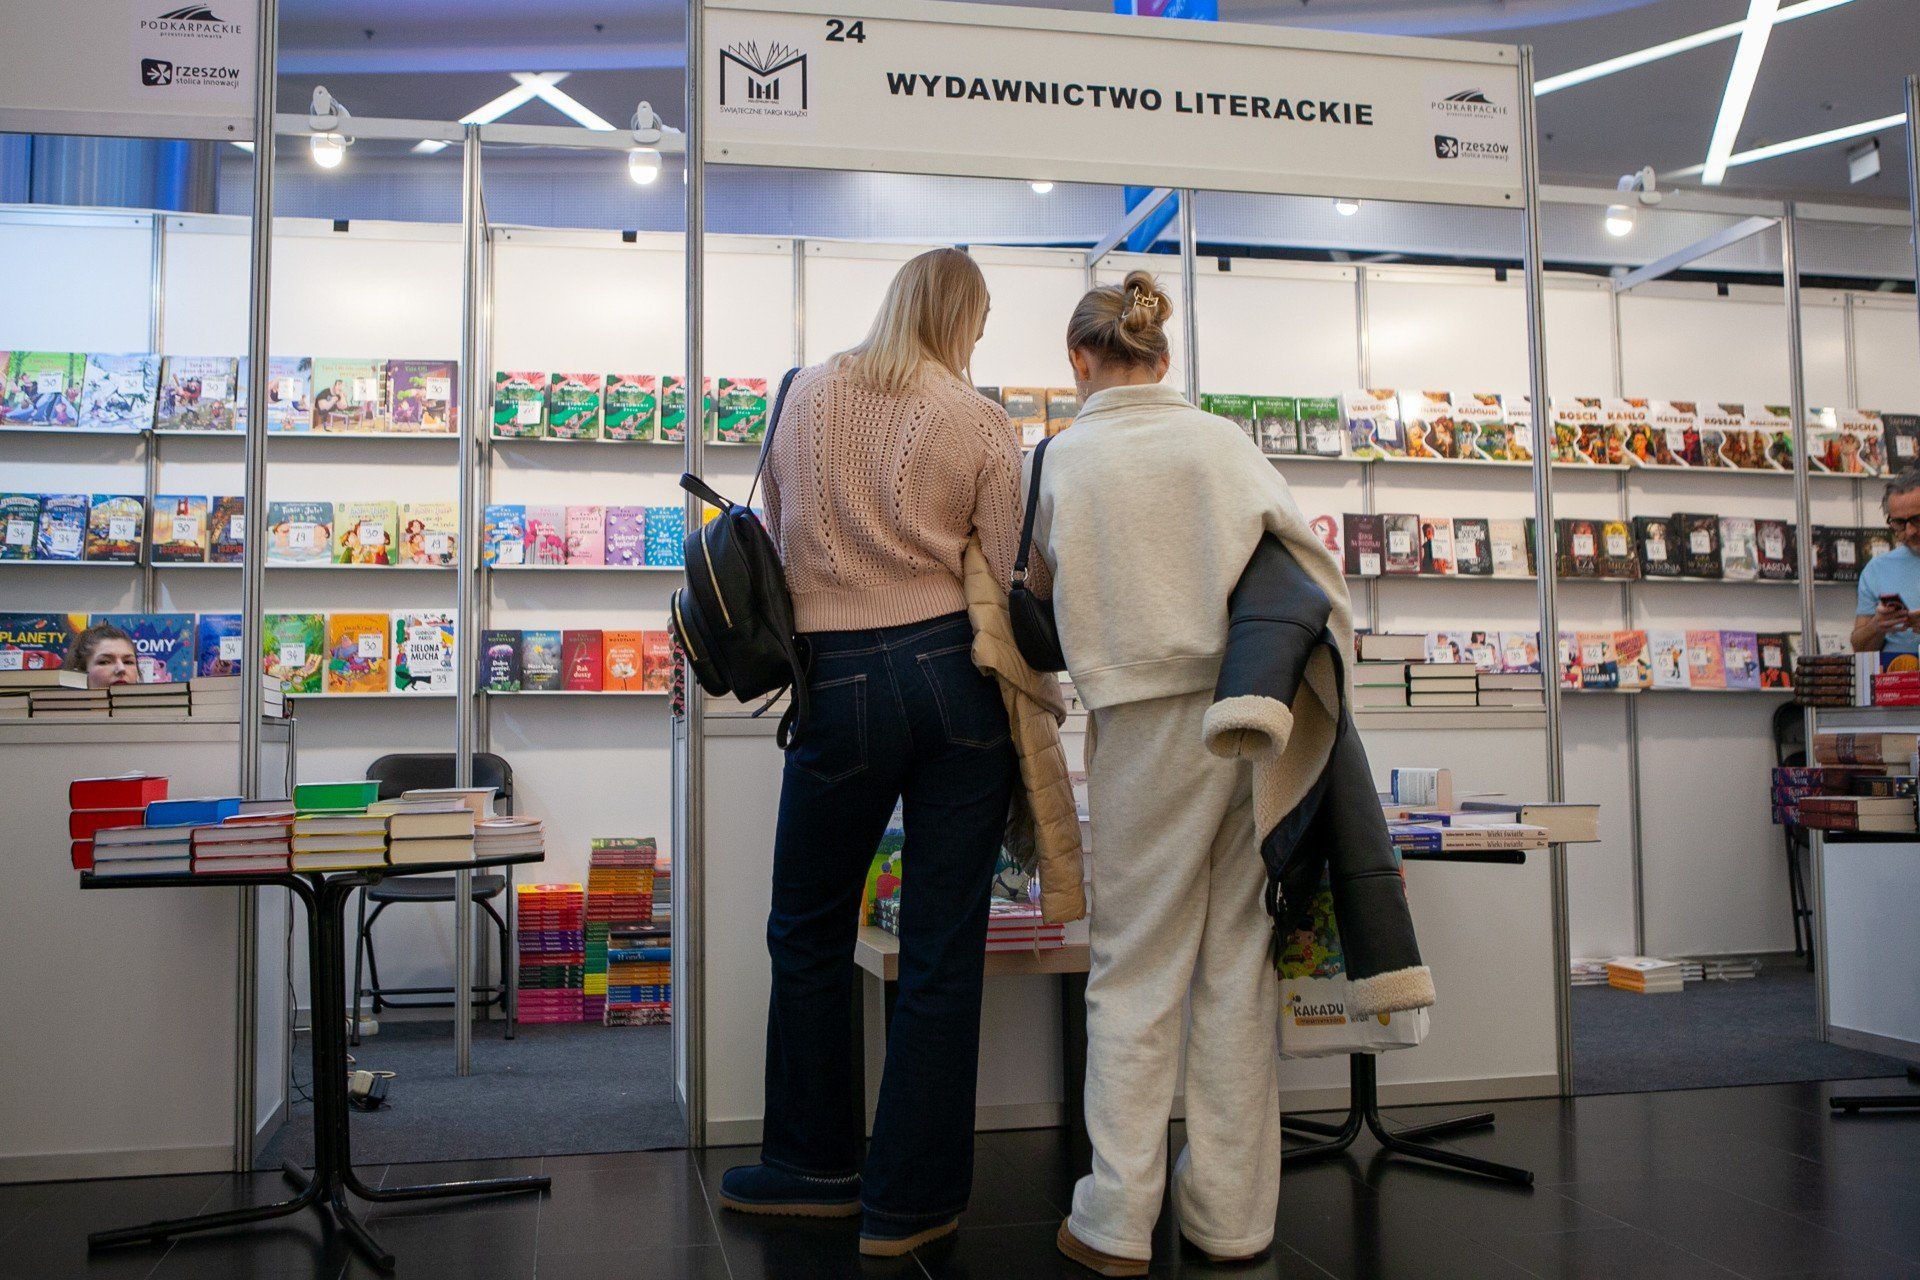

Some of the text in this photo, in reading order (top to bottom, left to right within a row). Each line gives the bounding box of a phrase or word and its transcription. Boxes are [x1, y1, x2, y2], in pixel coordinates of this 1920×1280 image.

[140, 20, 242, 34] PODKARPACKIE
[825, 19, 866, 43] 24
[175, 66, 240, 79] rzeszów
[175, 78, 240, 90] stolica innowacji
[886, 72, 1375, 126] WYDAWNICTWO LITERACKIE
[719, 105, 808, 118] ŚWIĄTECZNE TARGI KSIĄŻKI
[1431, 101, 1508, 115] PODKARPACKIE
[1460, 141, 1509, 153] rzeszów
[1352, 404, 1367, 413] VAN
[1559, 412, 1598, 420] BOSCH
[1607, 412, 1646, 420] KAHLO
[1843, 422, 1877, 431] MUCHA
[13, 526, 26, 537] 34
[365, 528, 379, 538] 30
[0, 631, 67, 643] PLANETY
[225, 644, 236, 655] 34
[365, 641, 377, 651] 30
[410, 644, 440, 652] ZIELONA
[287, 652, 298, 661] 34
[411, 652, 439, 661] MUCHA
[1293, 1003, 1344, 1017] KAKADU
